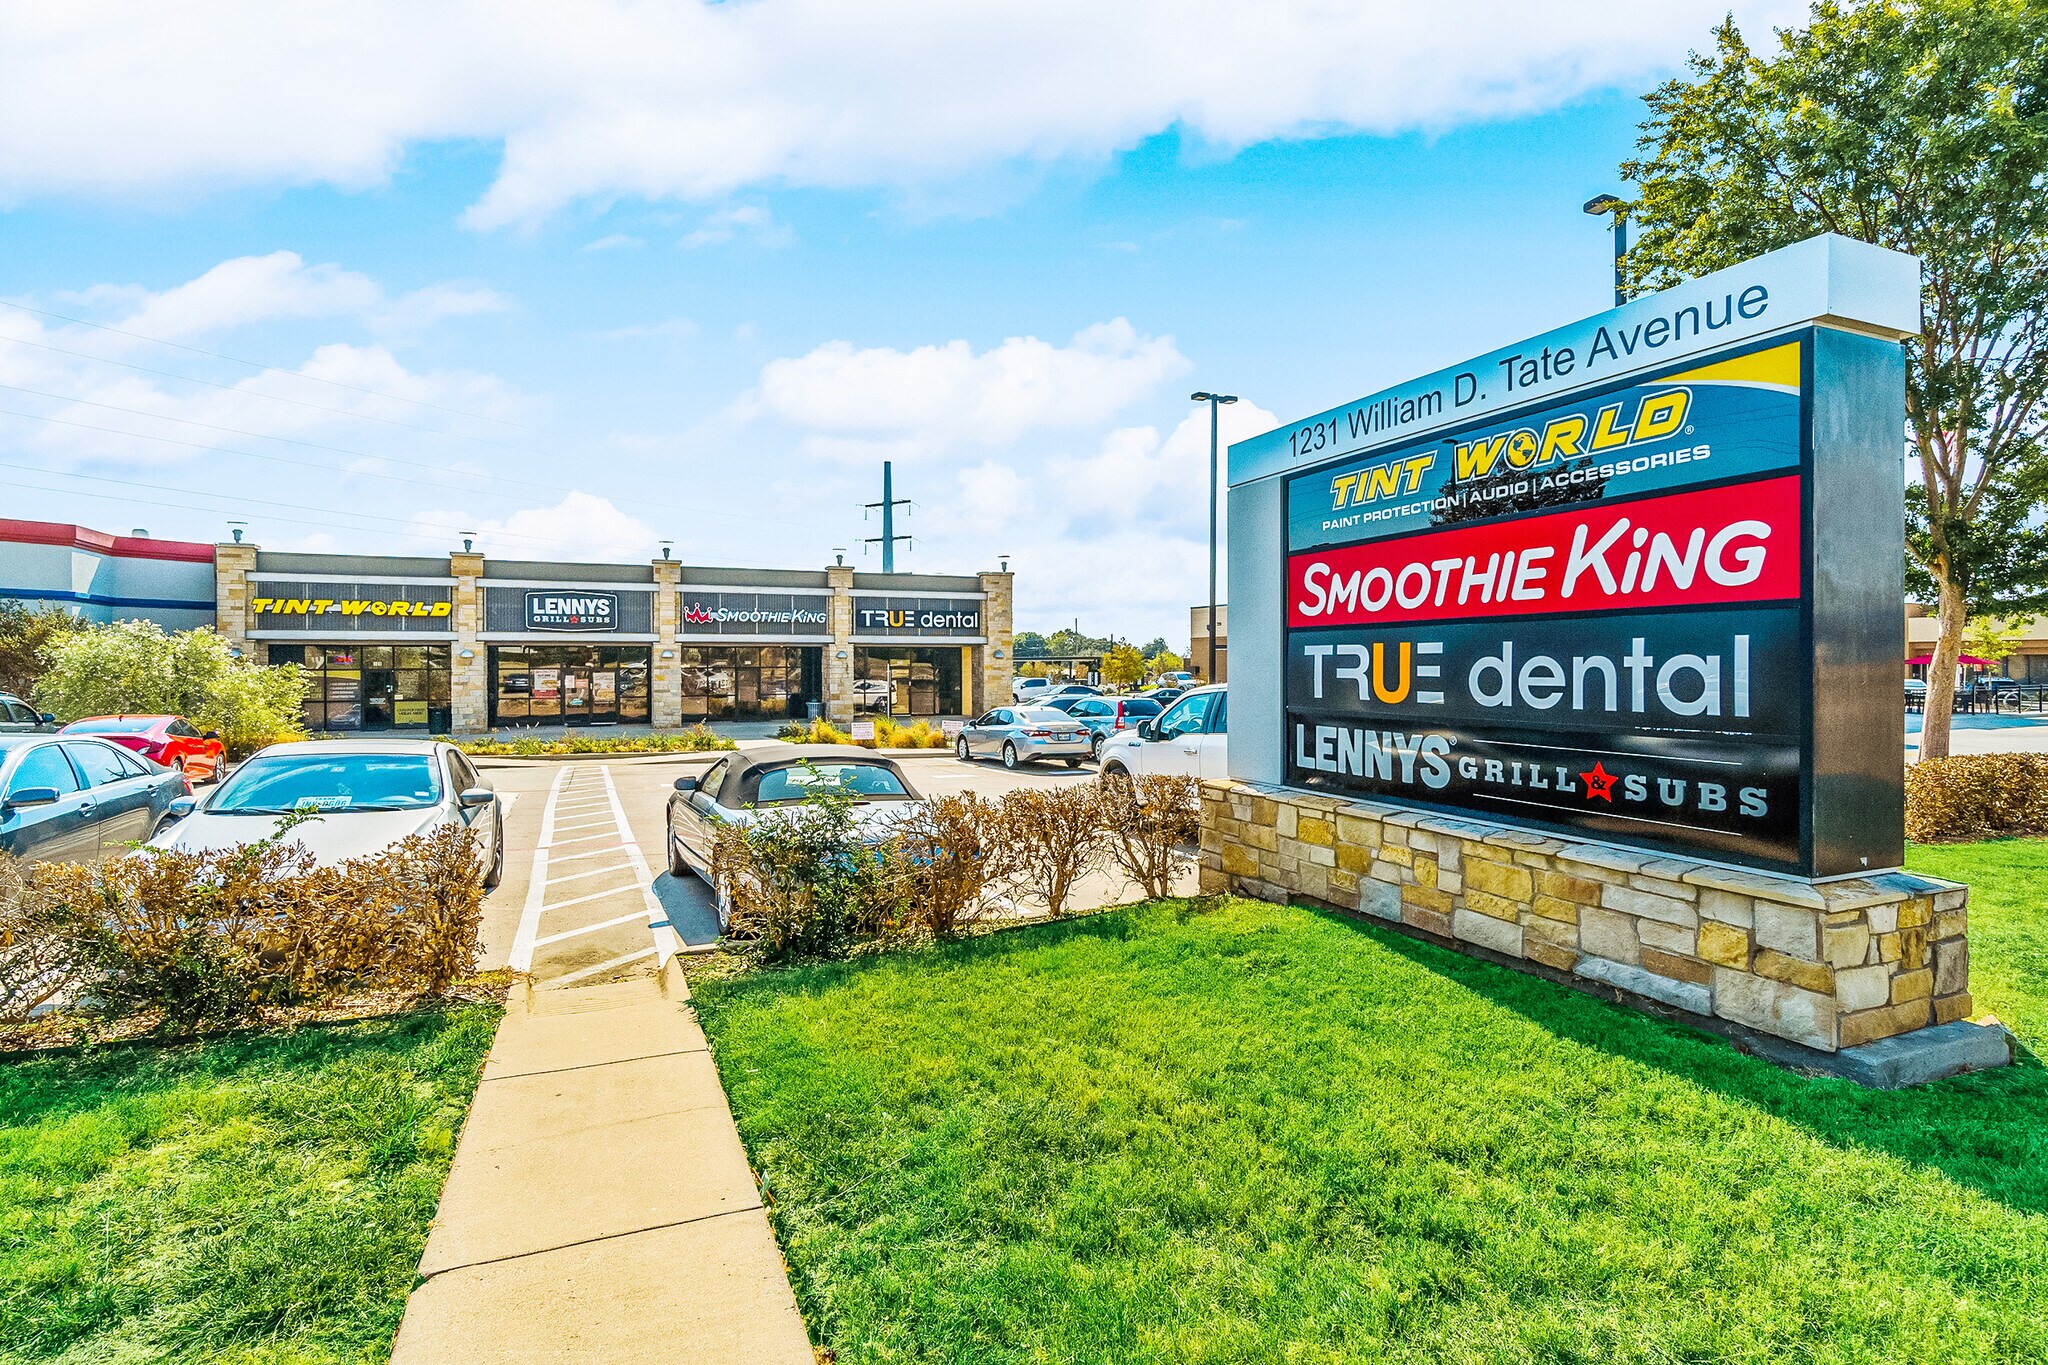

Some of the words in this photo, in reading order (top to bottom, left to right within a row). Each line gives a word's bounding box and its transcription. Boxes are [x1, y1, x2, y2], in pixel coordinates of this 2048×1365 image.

[1288, 417, 1338, 458] 1231
[1347, 389, 1442, 440] William
[1454, 371, 1487, 408] D.
[1498, 346, 1576, 392] Tate
[1586, 284, 1769, 368] Avenue
[1322, 515, 1361, 532] PAINT
[1363, 494, 1460, 523] PROTECTION
[1469, 481, 1529, 503] AUDIO
[1539, 444, 1711, 490] ACCESSORIES
[1331, 450, 1438, 510] TINT
[251, 598, 334, 615] TINT
[340, 600, 452, 617] WORLD
[533, 597, 610, 615] LENNYS
[1298, 545, 1555, 617] SMOOTHIE
[717, 607, 790, 623] SMOOTHIE
[860, 609, 915, 628] TRUE
[920, 610, 978, 629] dental
[1303, 641, 1445, 704] TRUE
[1468, 634, 1750, 718] dental
[1458, 760, 1576, 793] GRILL
[1591, 774, 1606, 791] &
[1624, 774, 1768, 817] SUBS
